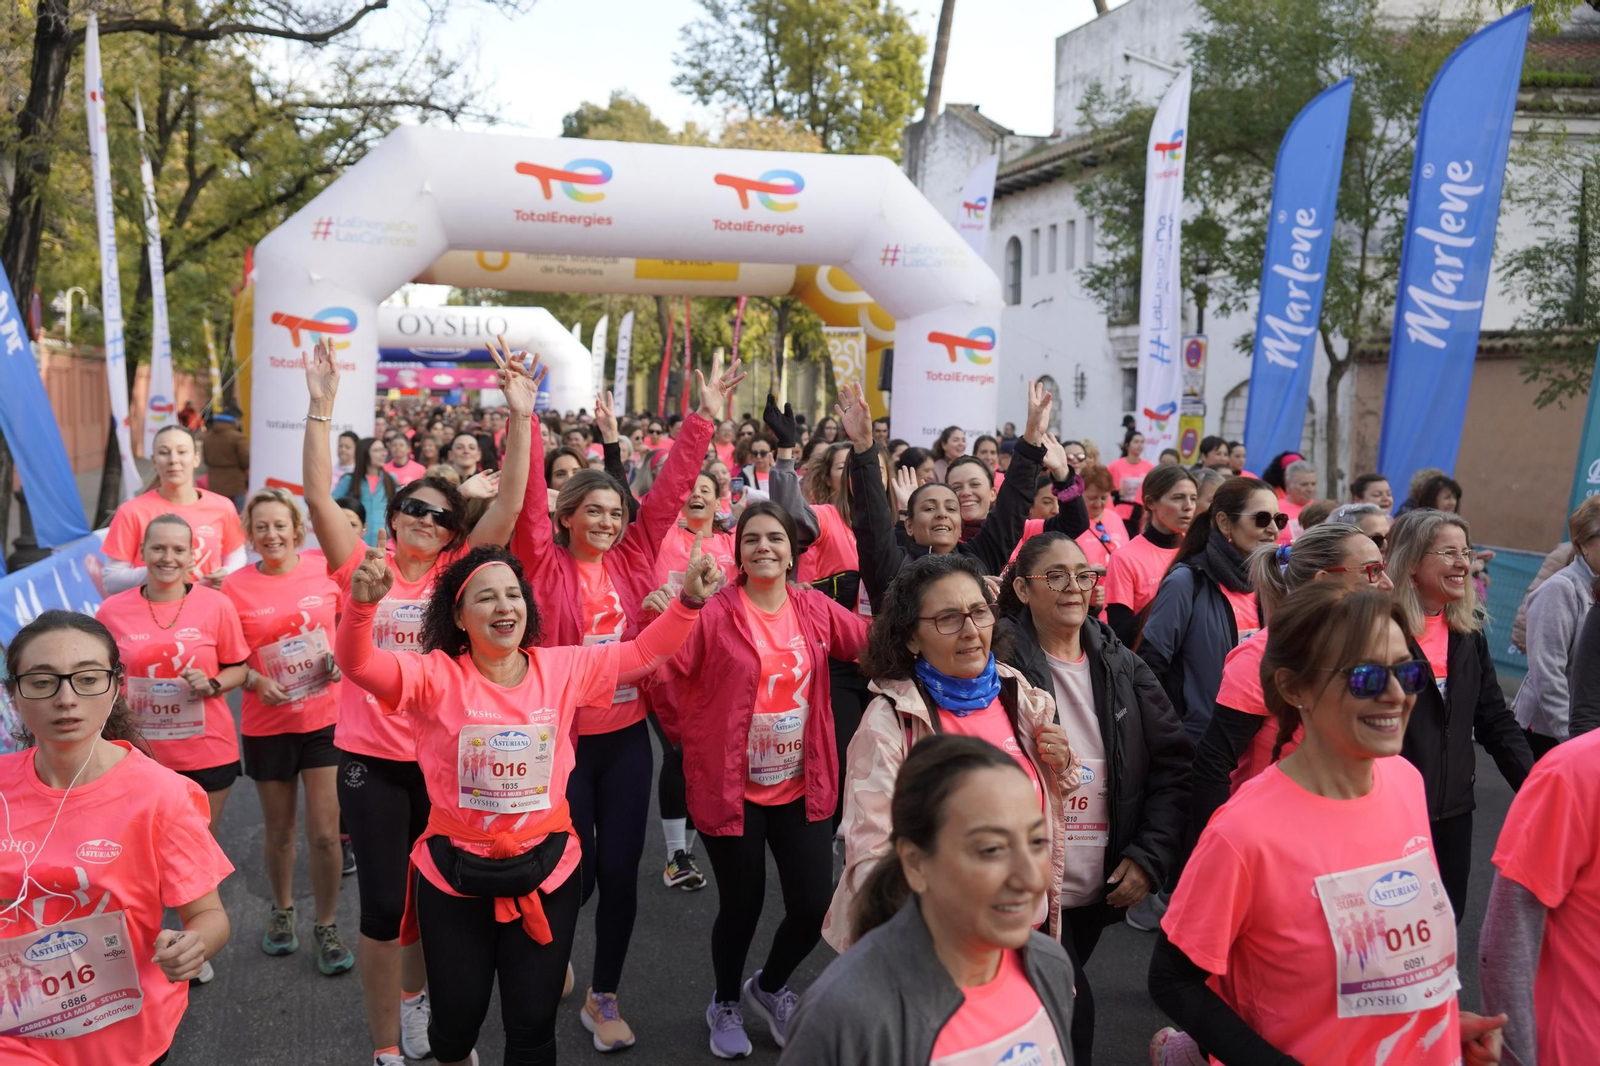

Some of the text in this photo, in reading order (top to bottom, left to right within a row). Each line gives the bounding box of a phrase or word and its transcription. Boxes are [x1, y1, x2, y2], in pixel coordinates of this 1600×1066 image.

[513, 209, 613, 227] TotalEnergies
[712, 218, 804, 236] TotalEnergies
[1404, 159, 1484, 349] Marlene
[1261, 207, 1323, 369] Marlene
[398, 313, 508, 336] OYSHO
[269, 356, 357, 371] TotalEies
[925, 371, 995, 385] TotalEnergies
[287, 659, 313, 674] 016
[152, 704, 180, 715] 016
[464, 708, 502, 718] OYSHO
[492, 737, 529, 747] ASTURIANA
[776, 739, 802, 755] 016
[492, 762, 527, 777] 016
[759, 774, 783, 782] OYSHO
[470, 798, 499, 808] OYSHO
[1065, 796, 1089, 811] 16
[0, 839, 36, 854] SHO
[79, 847, 120, 858] ASTURIANA
[1373, 883, 1420, 903] ASTURIANA
[1336, 897, 1366, 911] SUMA
[1385, 919, 1431, 952] 016
[30, 938, 84, 959] ASTURIANA
[0, 956, 23, 969] UMA
[1403, 956, 1426, 971] 6091
[41, 964, 96, 997] 016
[1361, 980, 1396, 990] CARRERA
[1396, 978, 1405, 986] DE
[1405, 975, 1415, 984] LA
[61, 994, 87, 1010] 6886
[1356, 993, 1408, 1009] OYSHO
[20, 991, 127, 1033] CARRERA DE LA MUJER SEVILLA
[94, 1004, 134, 1023] Santander
